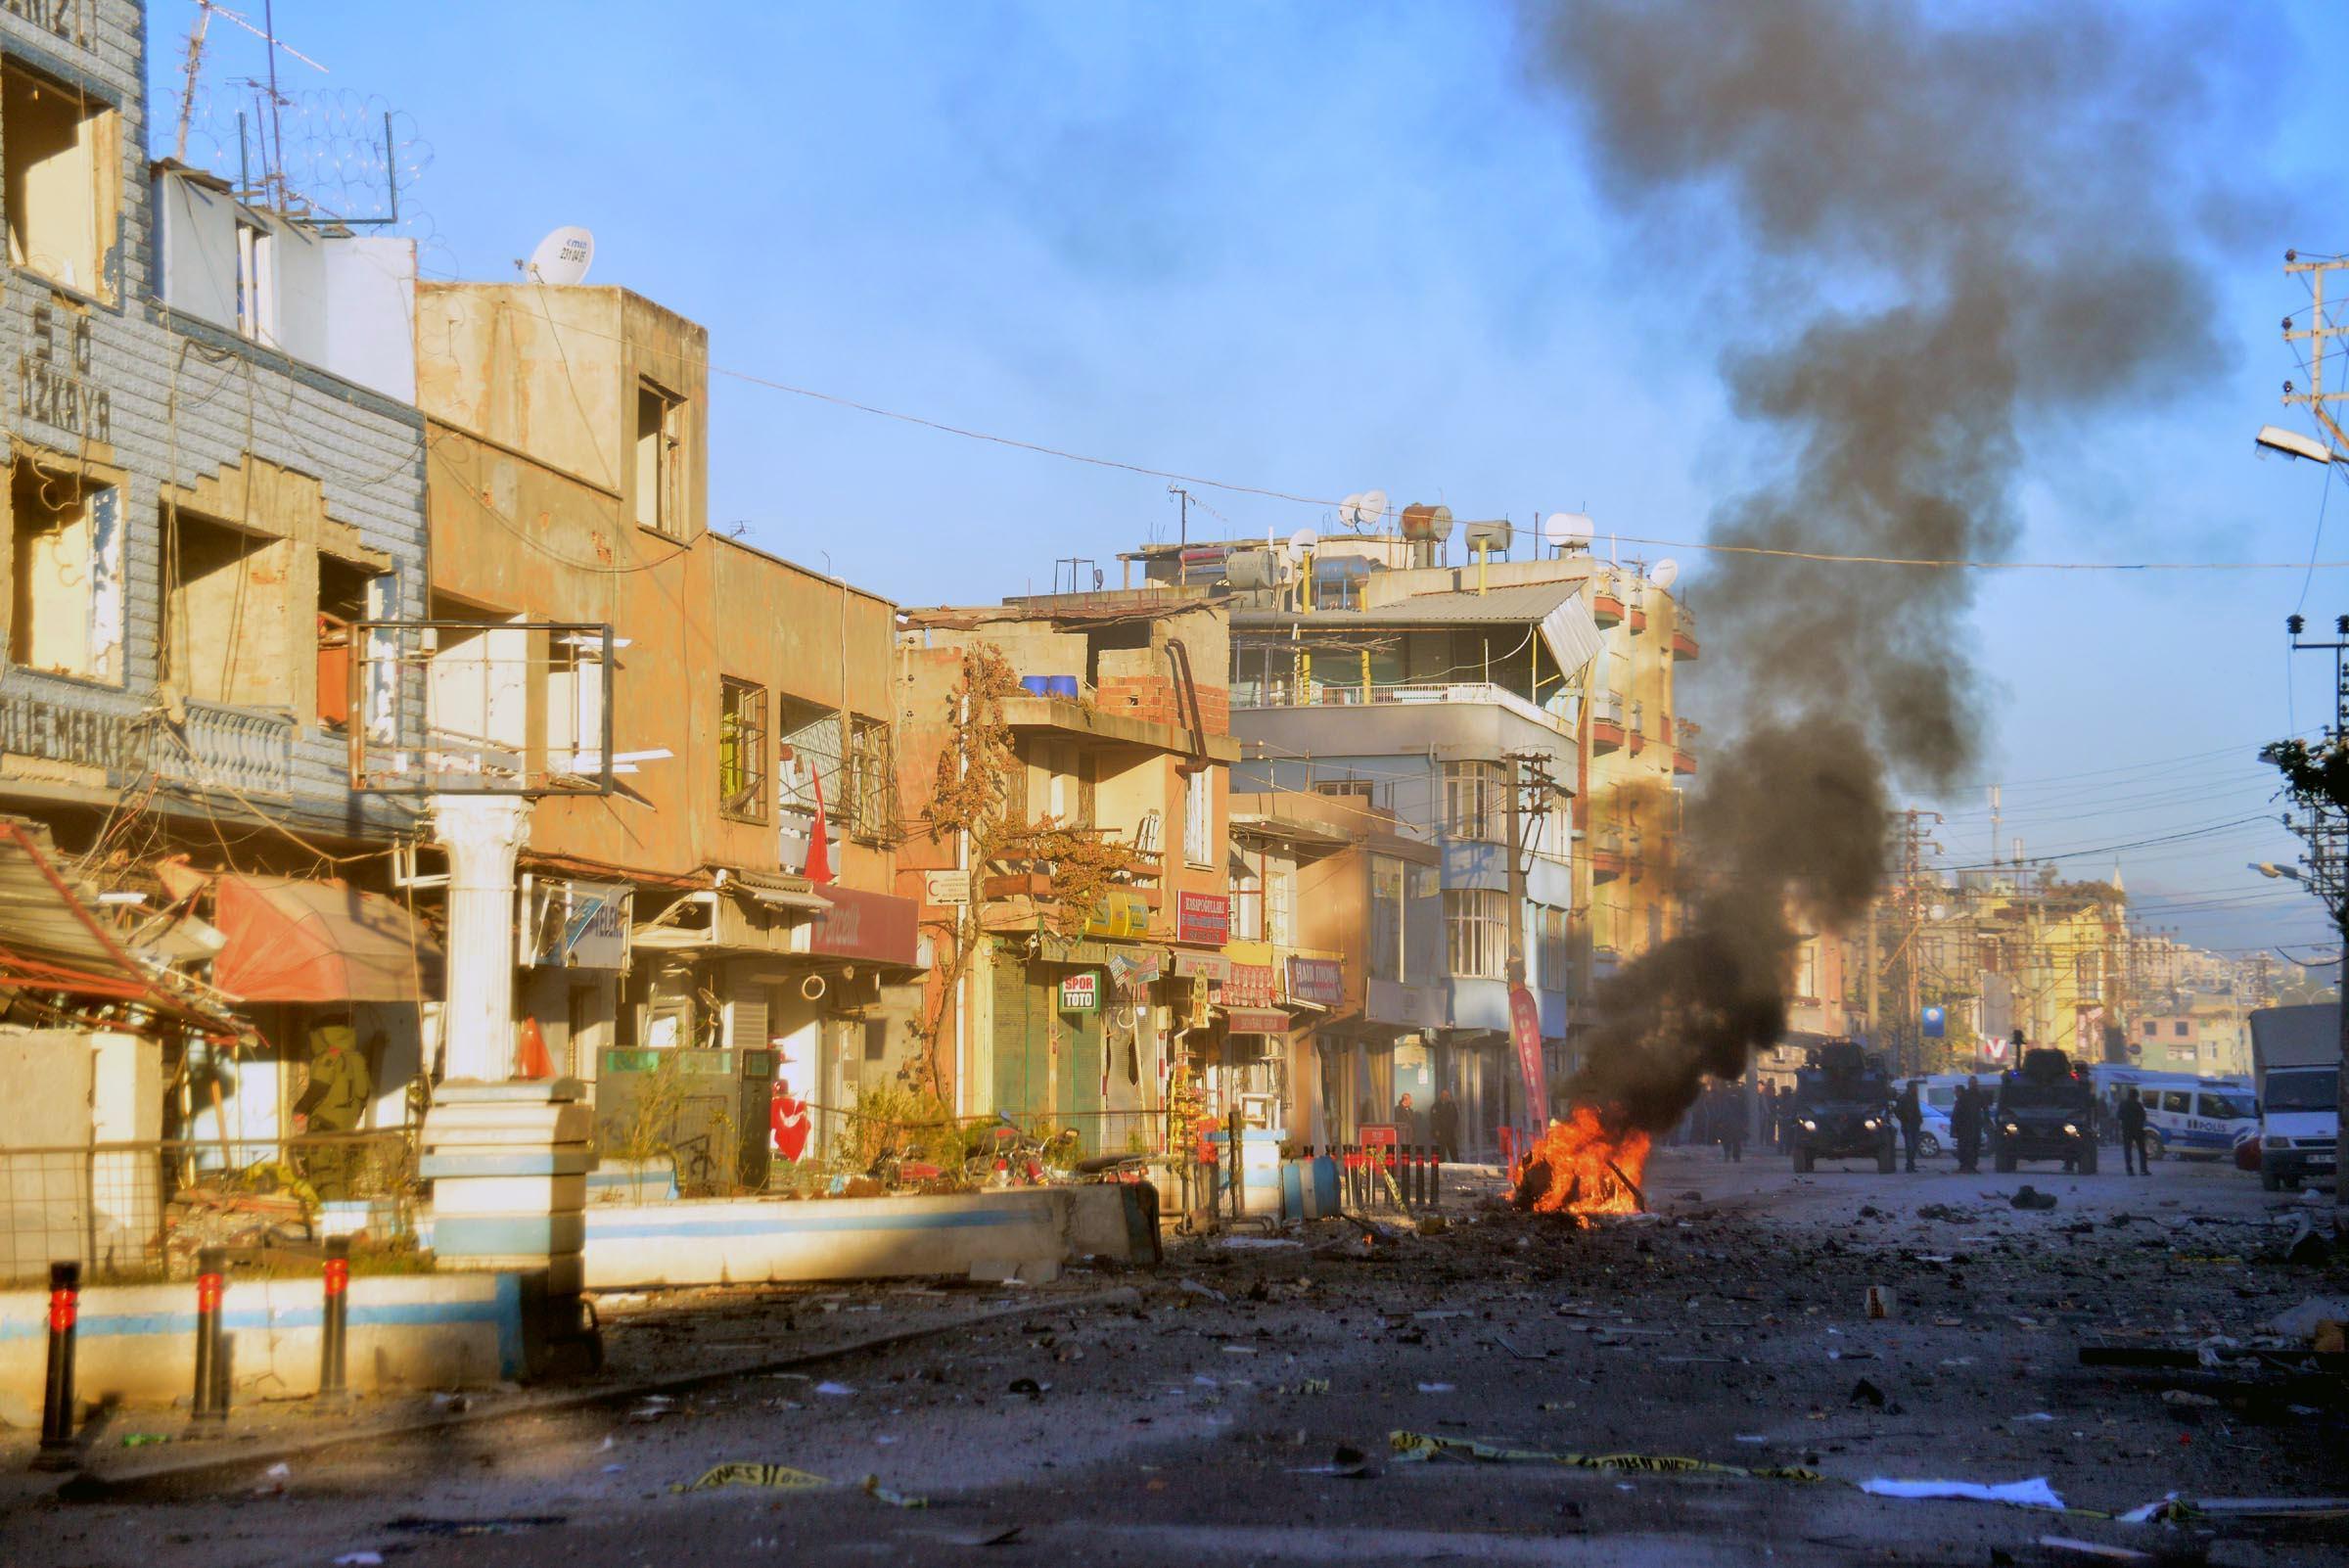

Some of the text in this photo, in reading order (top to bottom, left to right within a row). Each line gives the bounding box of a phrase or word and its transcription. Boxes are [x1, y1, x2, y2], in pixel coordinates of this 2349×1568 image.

[1295, 962, 1315, 984] HAIR
[1065, 977, 1094, 991] SPOR
[1065, 992, 1093, 1007] TOTO
